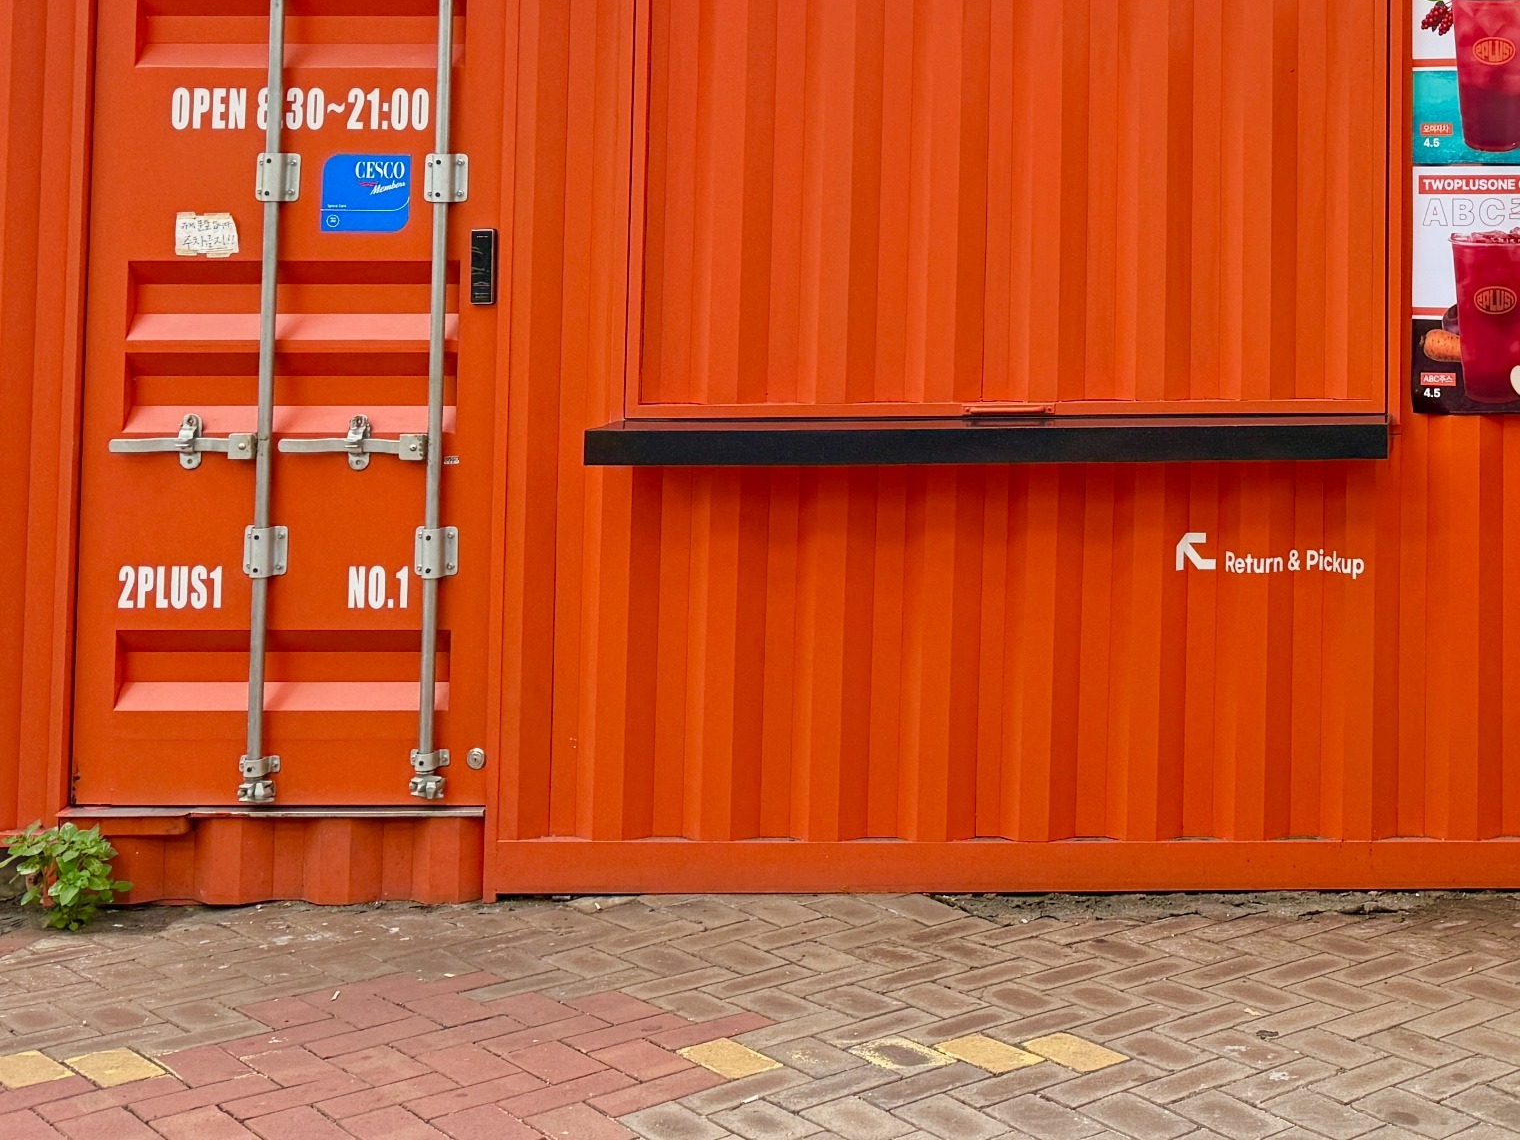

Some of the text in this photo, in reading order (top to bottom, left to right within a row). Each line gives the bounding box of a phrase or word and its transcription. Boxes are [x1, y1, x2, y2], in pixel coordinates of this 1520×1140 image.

[171, 87, 429, 131] OPEN 830~21:00
[1423, 137, 1440, 148] 4.5
[355, 161, 405, 179] CESCO
[369, 180, 406, 196] Members
[1423, 179, 1516, 191] TWOPLUSONE
[1423, 375, 1454, 384] ABC주스
[1423, 387, 1441, 398] 4.5
[1225, 548, 1365, 580] Return & Pickup
[117, 565, 223, 609] 2PLUS1
[347, 565, 409, 609] NO.1
